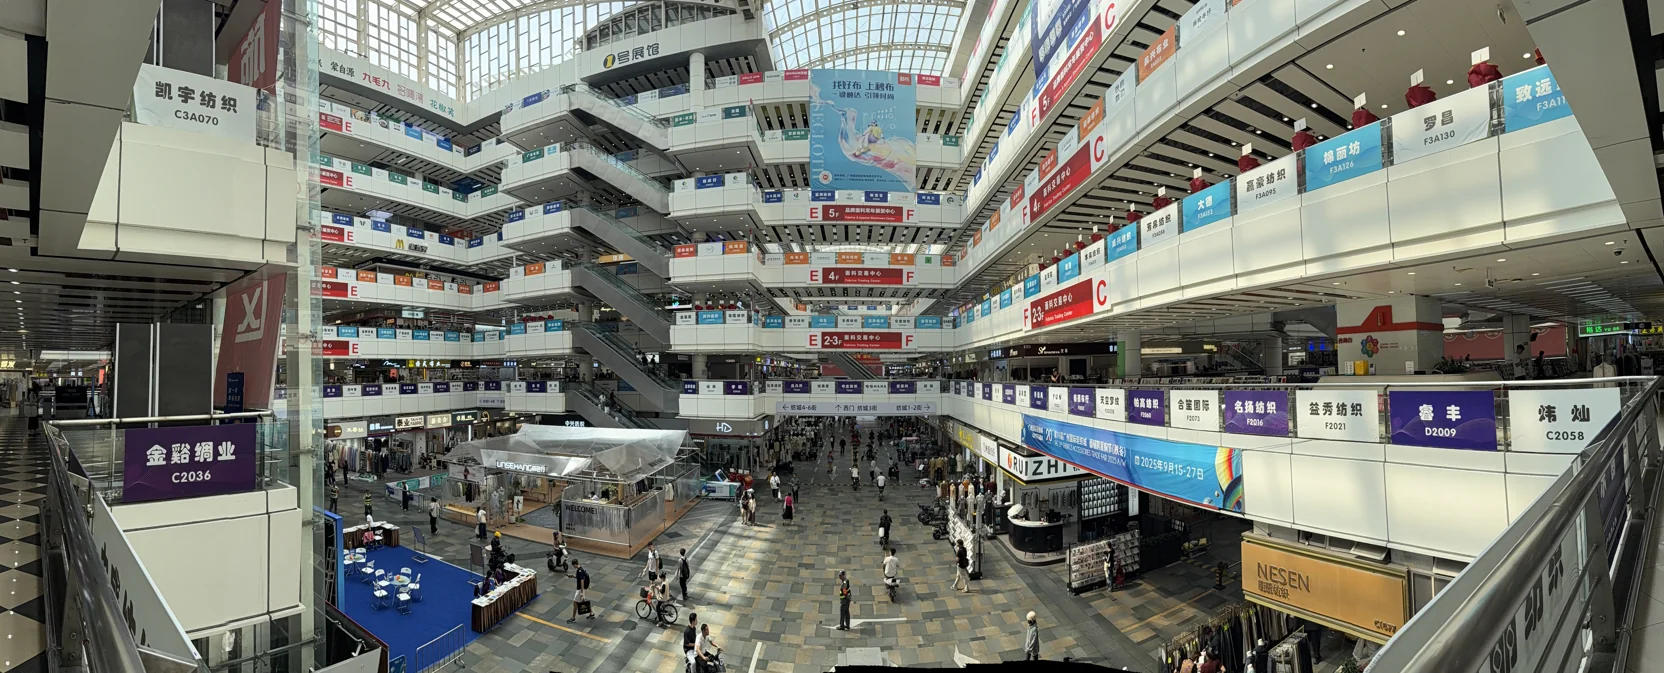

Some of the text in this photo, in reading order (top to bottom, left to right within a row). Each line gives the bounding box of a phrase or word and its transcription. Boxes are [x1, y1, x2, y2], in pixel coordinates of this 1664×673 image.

[1105, 2, 1116, 30] C
[362, 72, 391, 91] 九毛九
[832, 80, 862, 91] 找好布
[155, 81, 238, 115] 凯宇纺织
[174, 109, 219, 126] C3A070
[1423, 109, 1455, 133] 罗昌
[345, 121, 352, 133] E
[1423, 129, 1456, 146] F3A130
[1093, 135, 1105, 163] C
[1329, 160, 1354, 175] F3A126
[346, 176, 353, 187] E
[1255, 187, 1277, 201] F3A095
[810, 207, 819, 219] E
[828, 208, 840, 219] 5F
[906, 209, 915, 221] F
[1022, 205, 1028, 225] F
[347, 231, 354, 242] E
[810, 270, 819, 282] E
[828, 271, 839, 281] 4F
[906, 271, 915, 283] F
[351, 286, 357, 296] E
[1097, 279, 1108, 307] C
[1023, 308, 1029, 328] F
[809, 334, 818, 347] E
[824, 336, 843, 346] 2-3F
[905, 335, 914, 347] F
[352, 343, 359, 355] E
[1233, 400, 1277, 416] 名扬纺织
[1308, 402, 1364, 419] 益秀纺织
[1246, 418, 1264, 428] F2016
[1325, 421, 1347, 432] F2021
[1424, 426, 1457, 439] D2009
[1545, 430, 1585, 443] C2058
[1013, 455, 1067, 477] RUIZHI
[1140, 456, 1204, 481] 2025年9月15-27日
[171, 471, 212, 484] C2036
[1257, 562, 1311, 594] NESEN
